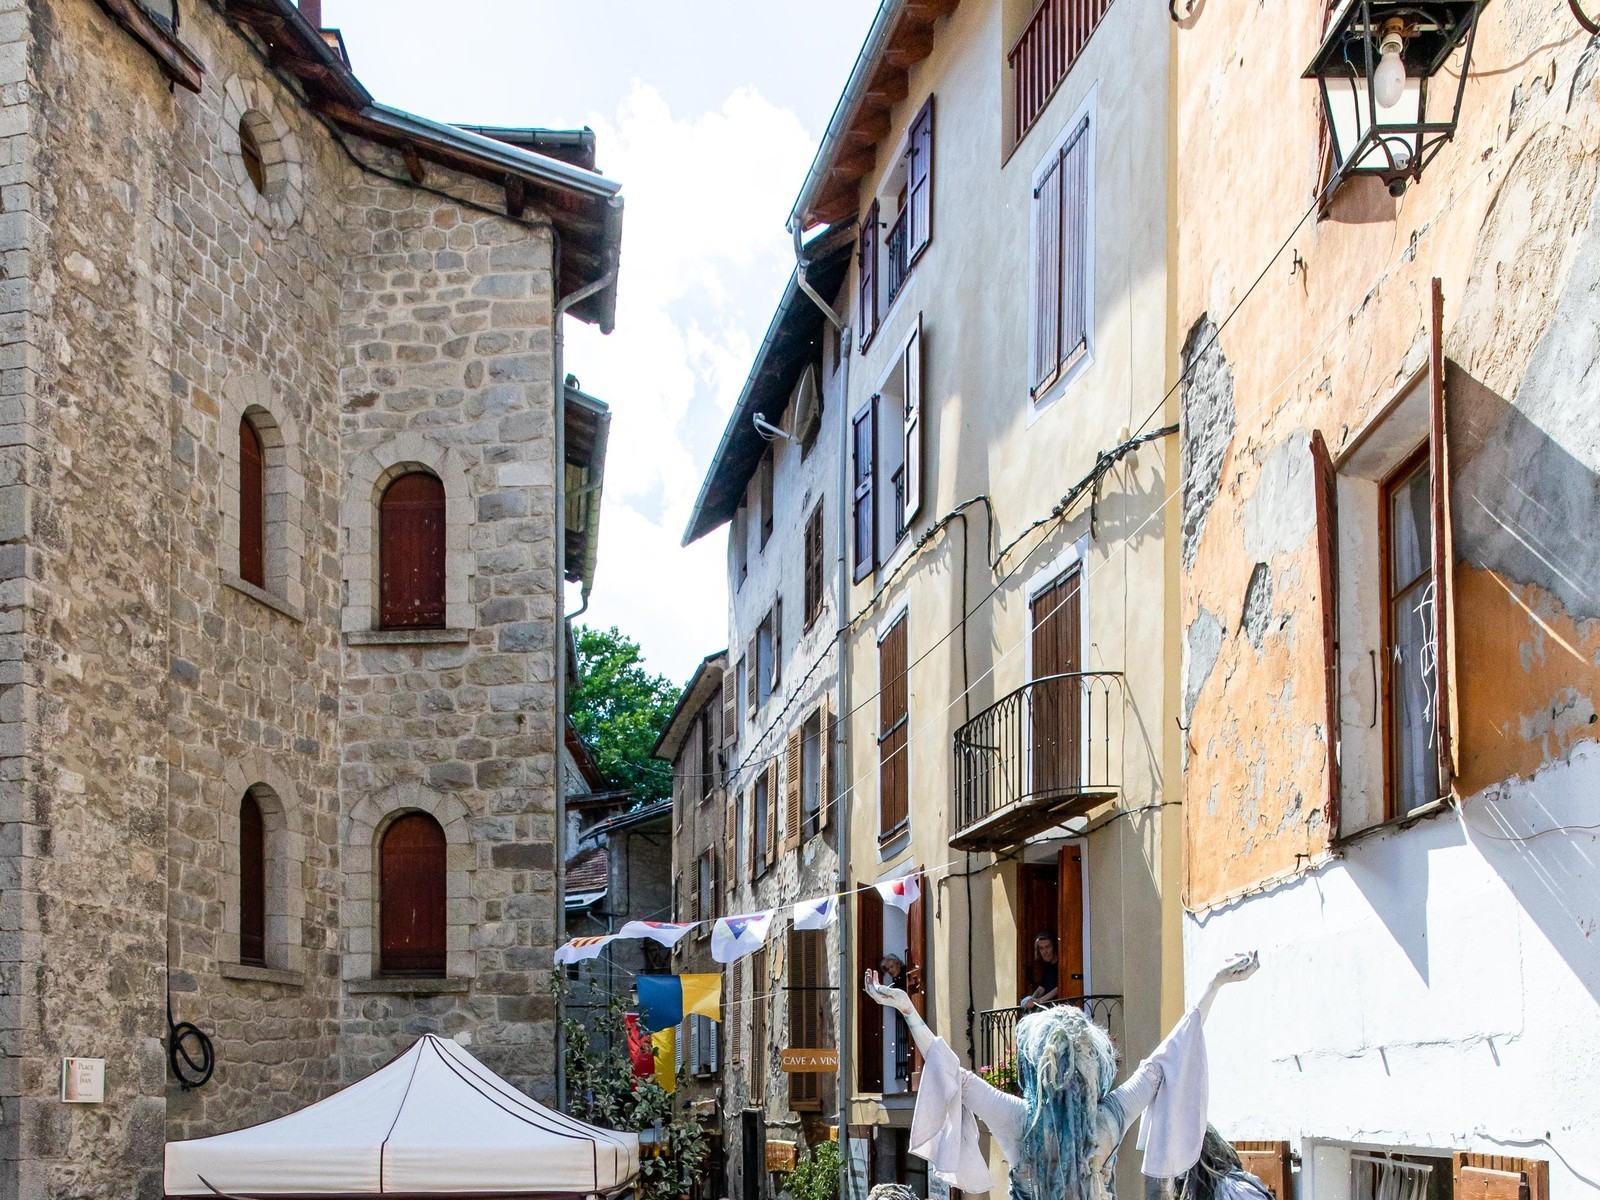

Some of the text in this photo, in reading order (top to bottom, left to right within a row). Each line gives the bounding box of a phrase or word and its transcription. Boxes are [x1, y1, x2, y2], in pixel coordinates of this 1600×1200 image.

[783, 1056, 837, 1065] CAVE A VIN
